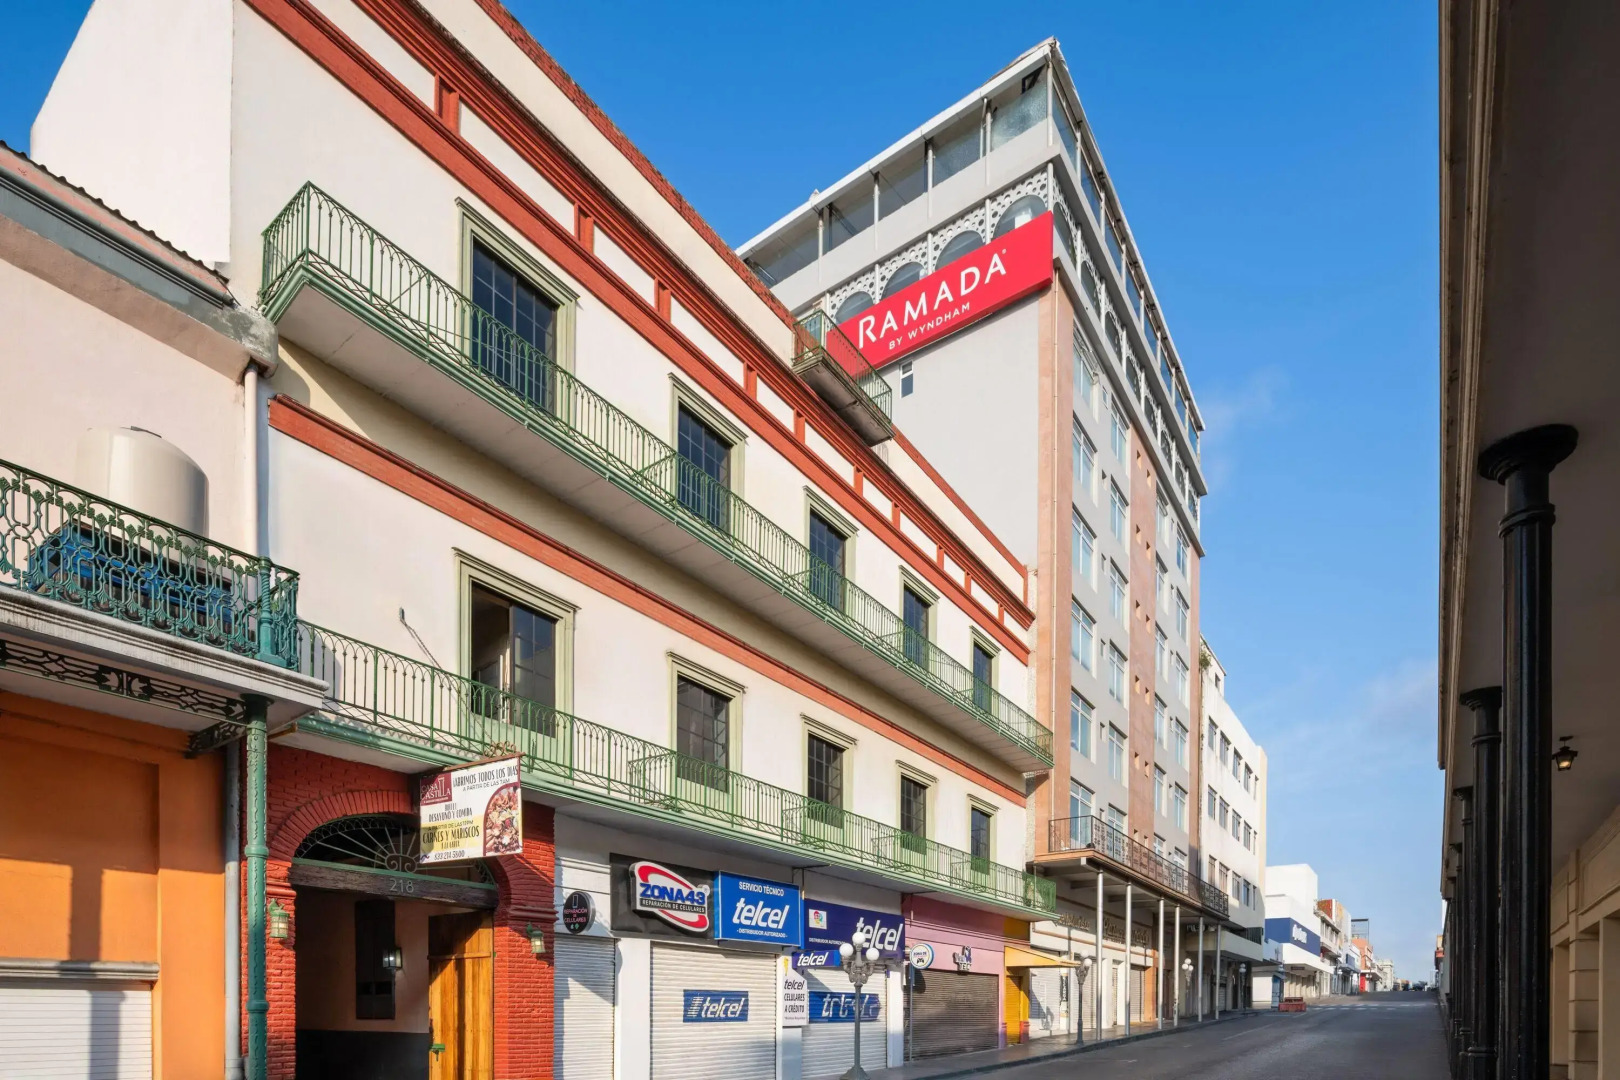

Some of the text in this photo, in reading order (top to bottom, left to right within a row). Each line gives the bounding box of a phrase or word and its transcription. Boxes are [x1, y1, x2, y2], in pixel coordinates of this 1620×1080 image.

[858, 253, 1006, 349] RAMADA
[889, 302, 970, 350] BY WYNDHAM
[478, 769, 495, 783] TODOS
[496, 767, 506, 780] LOS
[421, 783, 439, 793] CASA
[428, 811, 451, 823] DESAYUNO
[451, 810, 456, 819] Y
[422, 825, 480, 844] CARNES Y MARISCOS
[390, 877, 414, 893] 218
[738, 881, 785, 897] SERVICIO TÉCNICO
[642, 899, 671, 909] REPARACIÓN
[679, 904, 705, 913] CELULARES
[732, 897, 790, 930] telcel
[856, 917, 904, 951] telcel
[797, 951, 830, 967] telcel
[784, 979, 805, 990] telcel
[783, 993, 806, 1002] CELULARES
[701, 996, 746, 1018] telcel
[784, 1002, 805, 1013] A CRÉDITO
